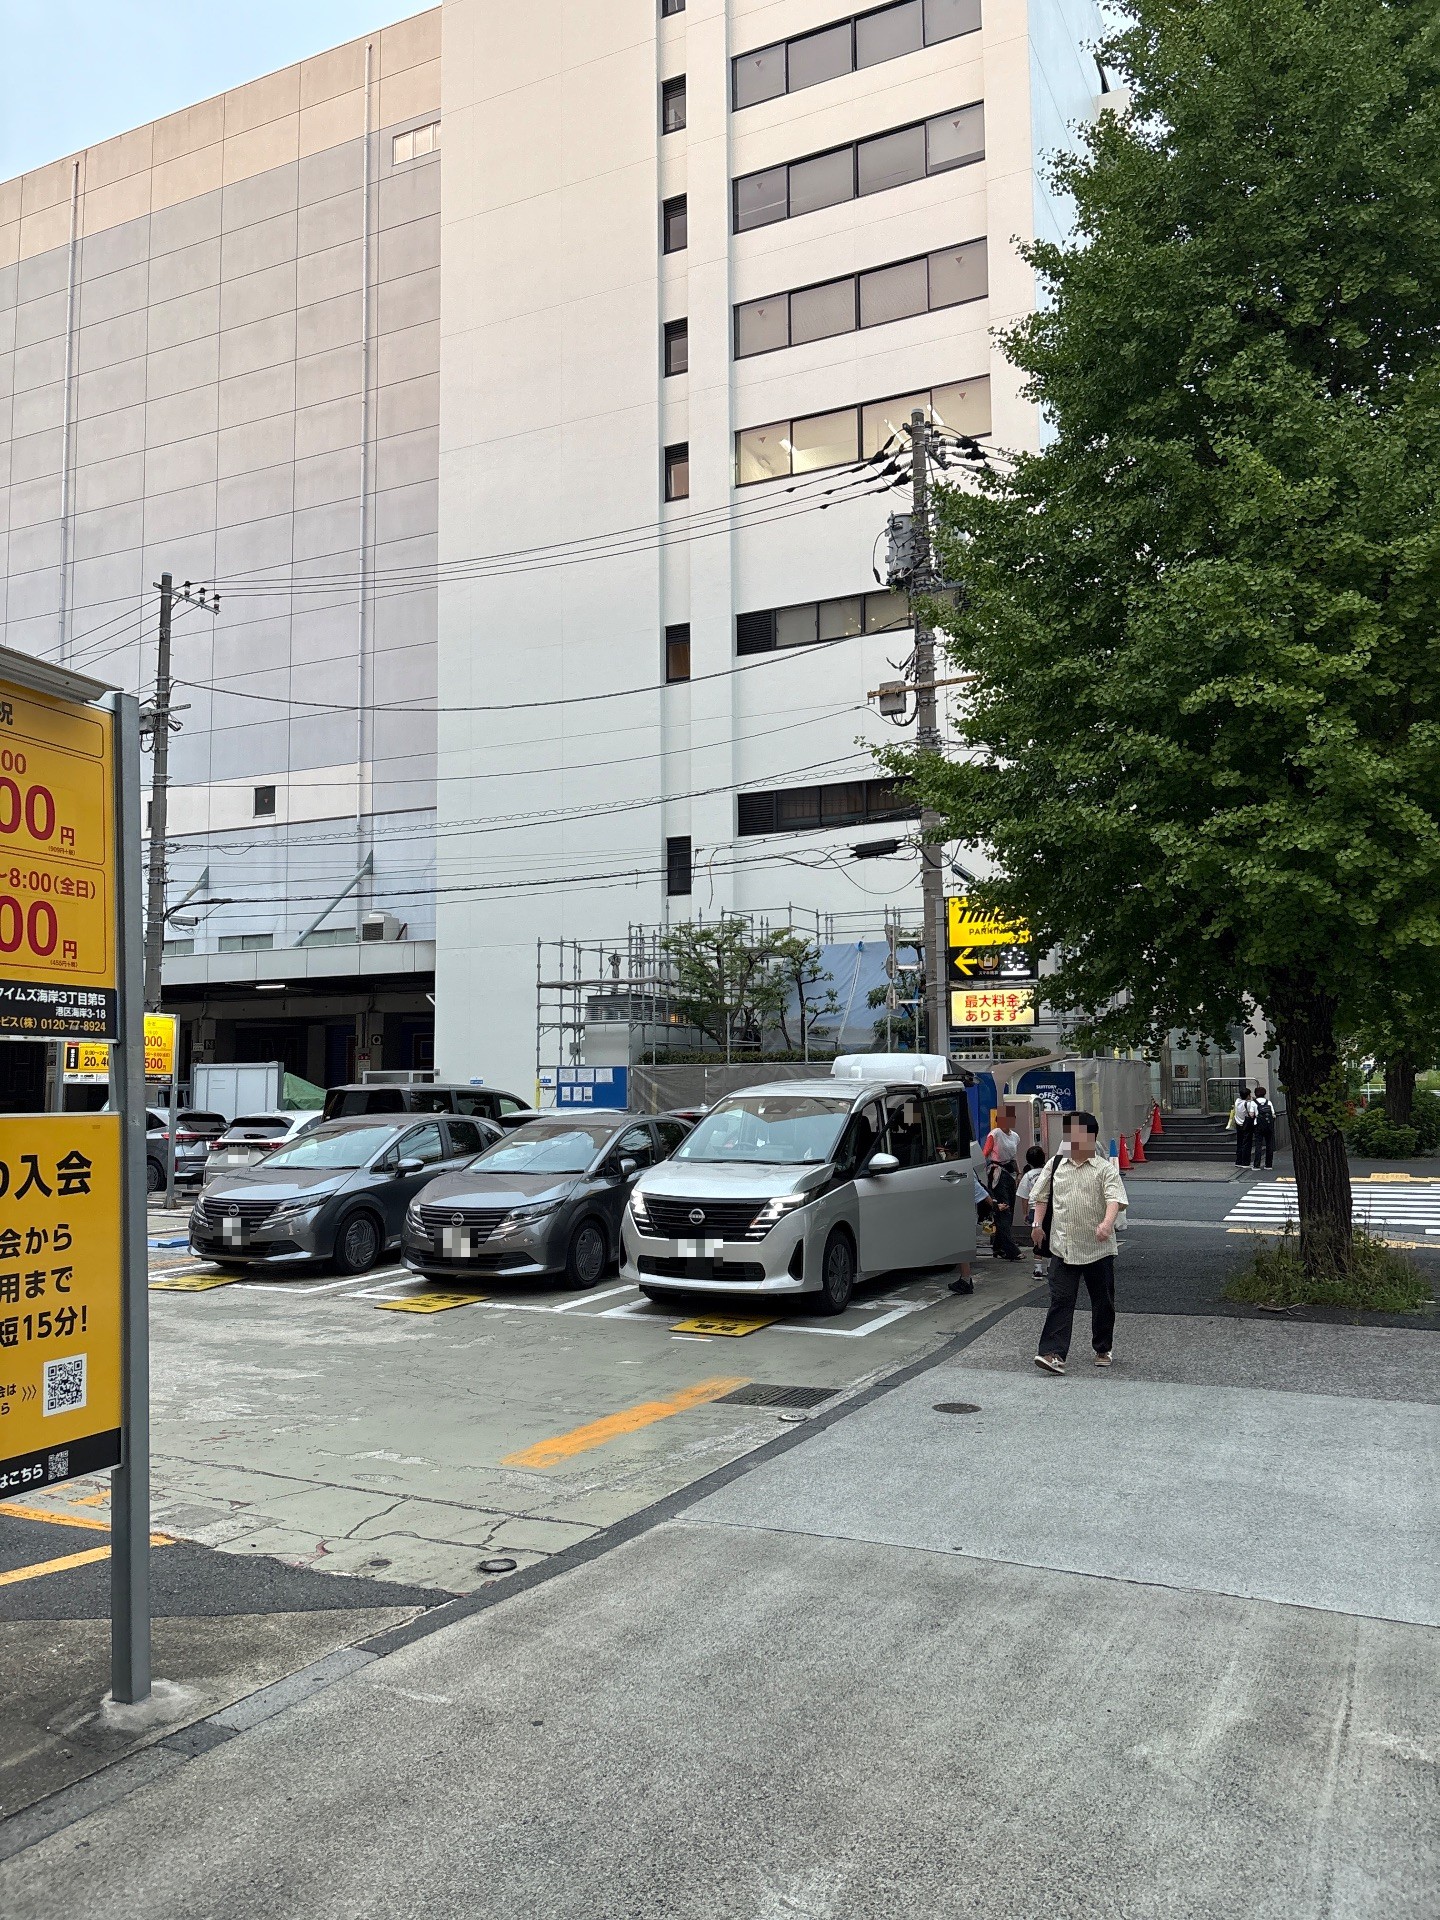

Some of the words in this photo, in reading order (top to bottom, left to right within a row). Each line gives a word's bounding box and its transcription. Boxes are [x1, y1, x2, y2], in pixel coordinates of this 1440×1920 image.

[965, 994, 1020, 1008] 最大料金
[55, 1006, 107, 1019] 港区海岸3-18
[965, 1009, 1019, 1023] あります
[0, 1016, 38, 1029] ビス(株)
[40, 1018, 107, 1032] 0120-77-8924
[0, 1224, 73, 1260] 会から
[0, 1266, 73, 1303] 用まで
